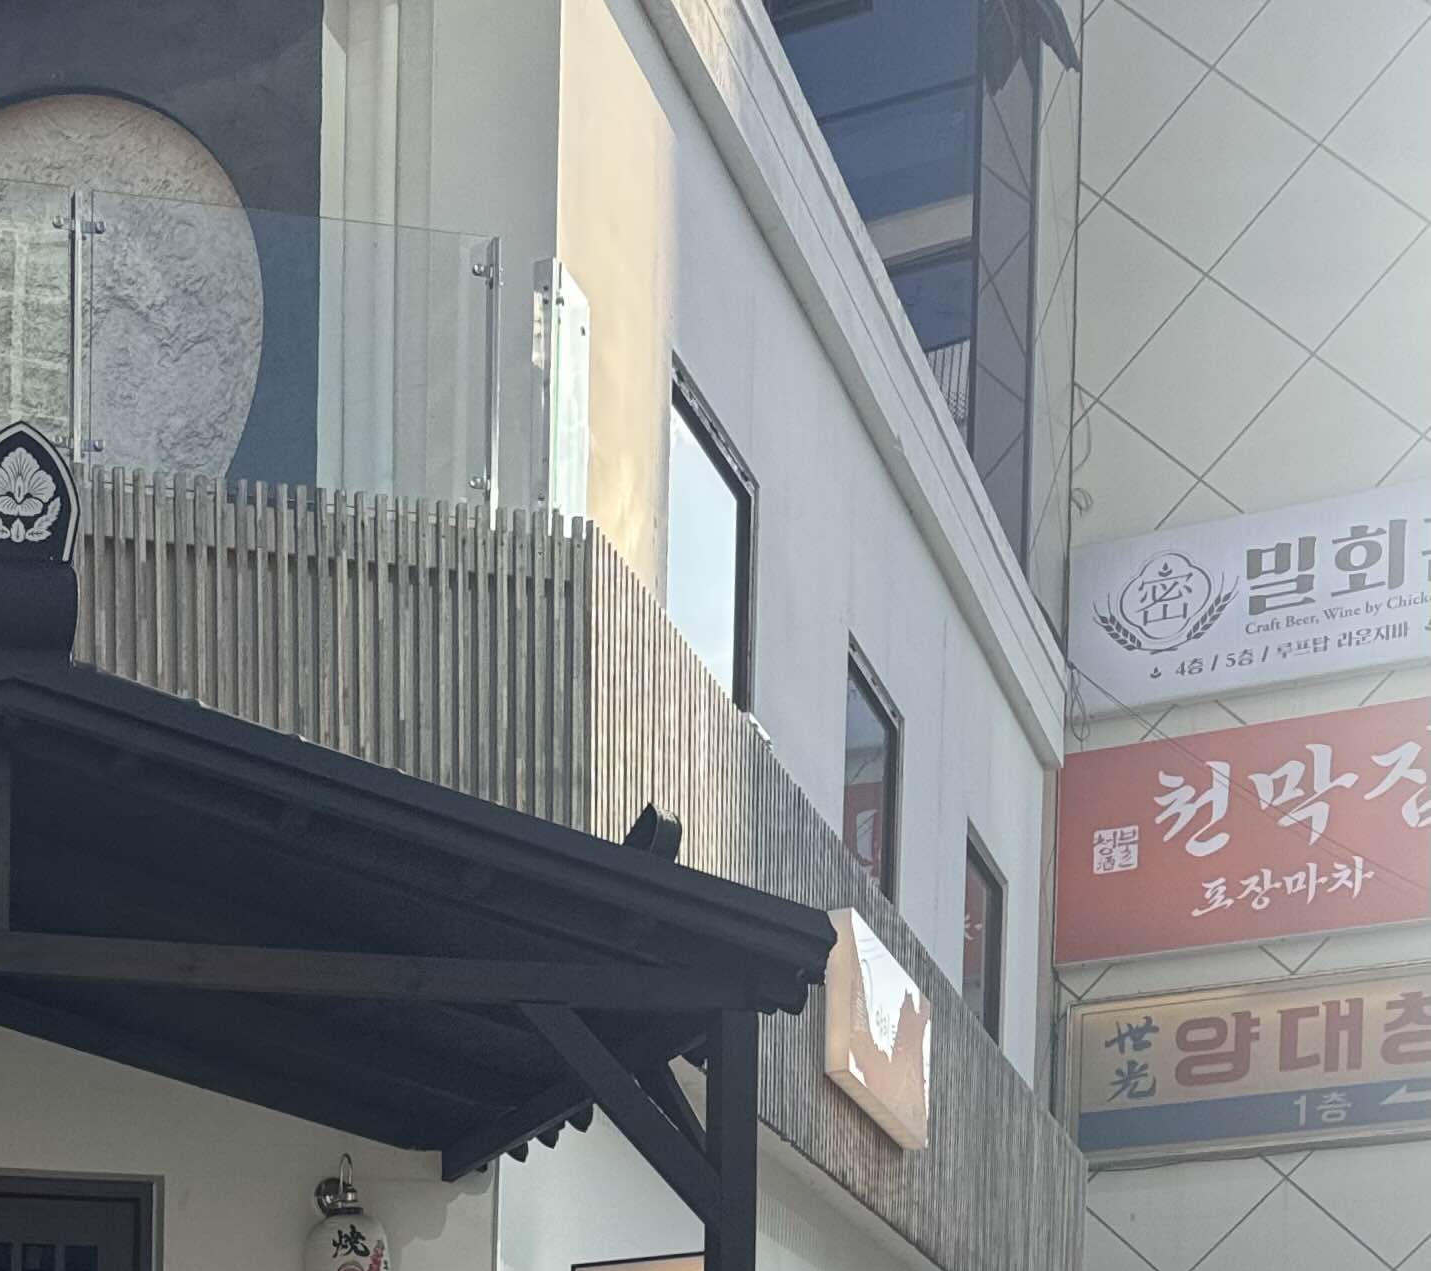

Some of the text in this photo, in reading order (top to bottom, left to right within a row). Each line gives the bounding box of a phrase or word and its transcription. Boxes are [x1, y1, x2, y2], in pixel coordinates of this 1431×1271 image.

[1246, 518, 1431, 616] 밀회
[1138, 572, 1194, 626] 密
[1245, 592, 1431, 636] Craft Beer, Wine by Chick
[1175, 655, 1204, 677] 4층
[1226, 648, 1254, 669] 5층
[1276, 635, 1330, 660] 루프탑
[1336, 621, 1409, 649] 라운지바
[1191, 855, 1375, 918] 포장마차
[1293, 1091, 1352, 1127] 1층
